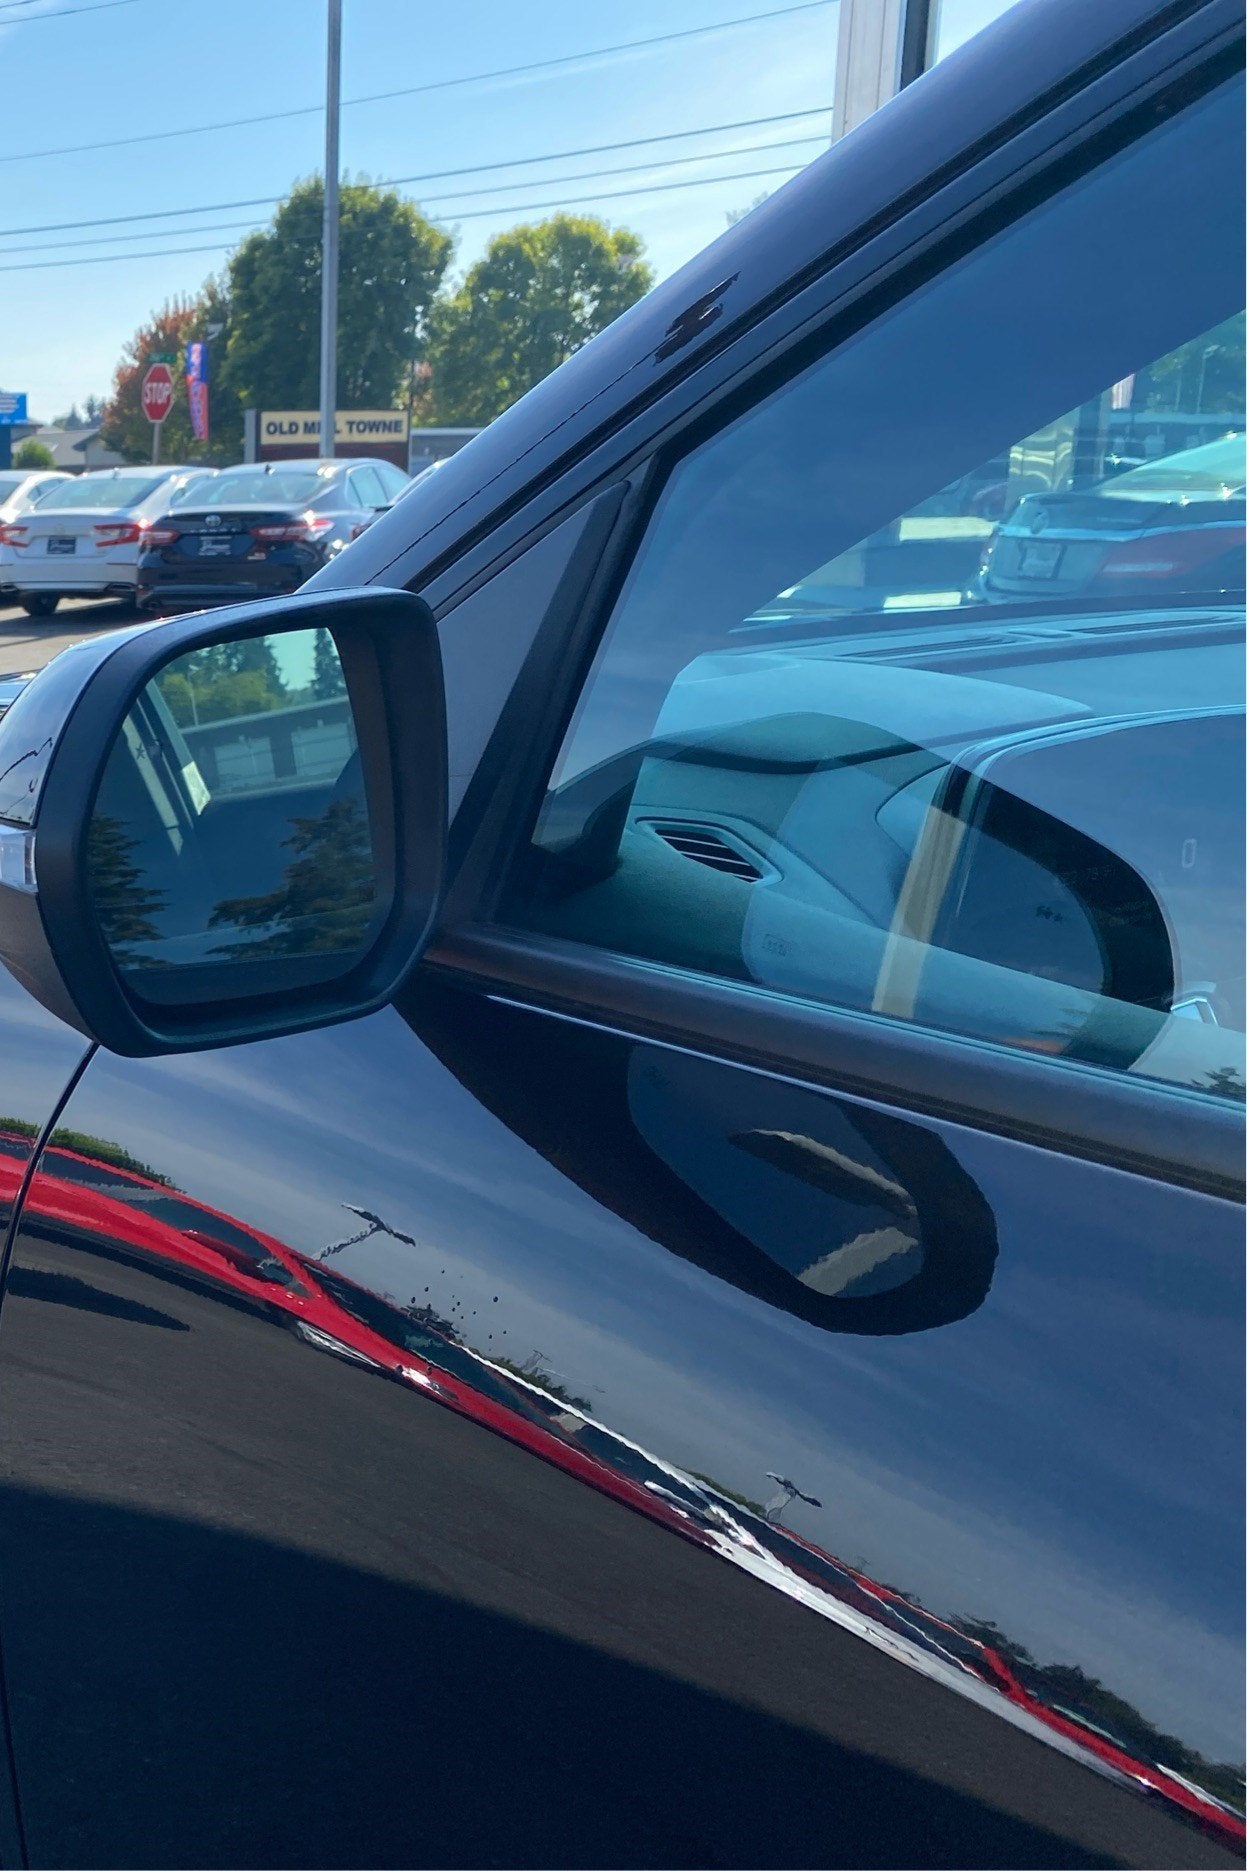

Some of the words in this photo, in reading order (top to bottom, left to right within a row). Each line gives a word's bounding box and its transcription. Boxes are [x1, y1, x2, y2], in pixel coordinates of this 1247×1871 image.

[144, 382, 171, 404] STOP
[266, 422, 299, 435] OLD
[303, 421, 341, 434] MIL
[346, 420, 403, 434] TOWNE
